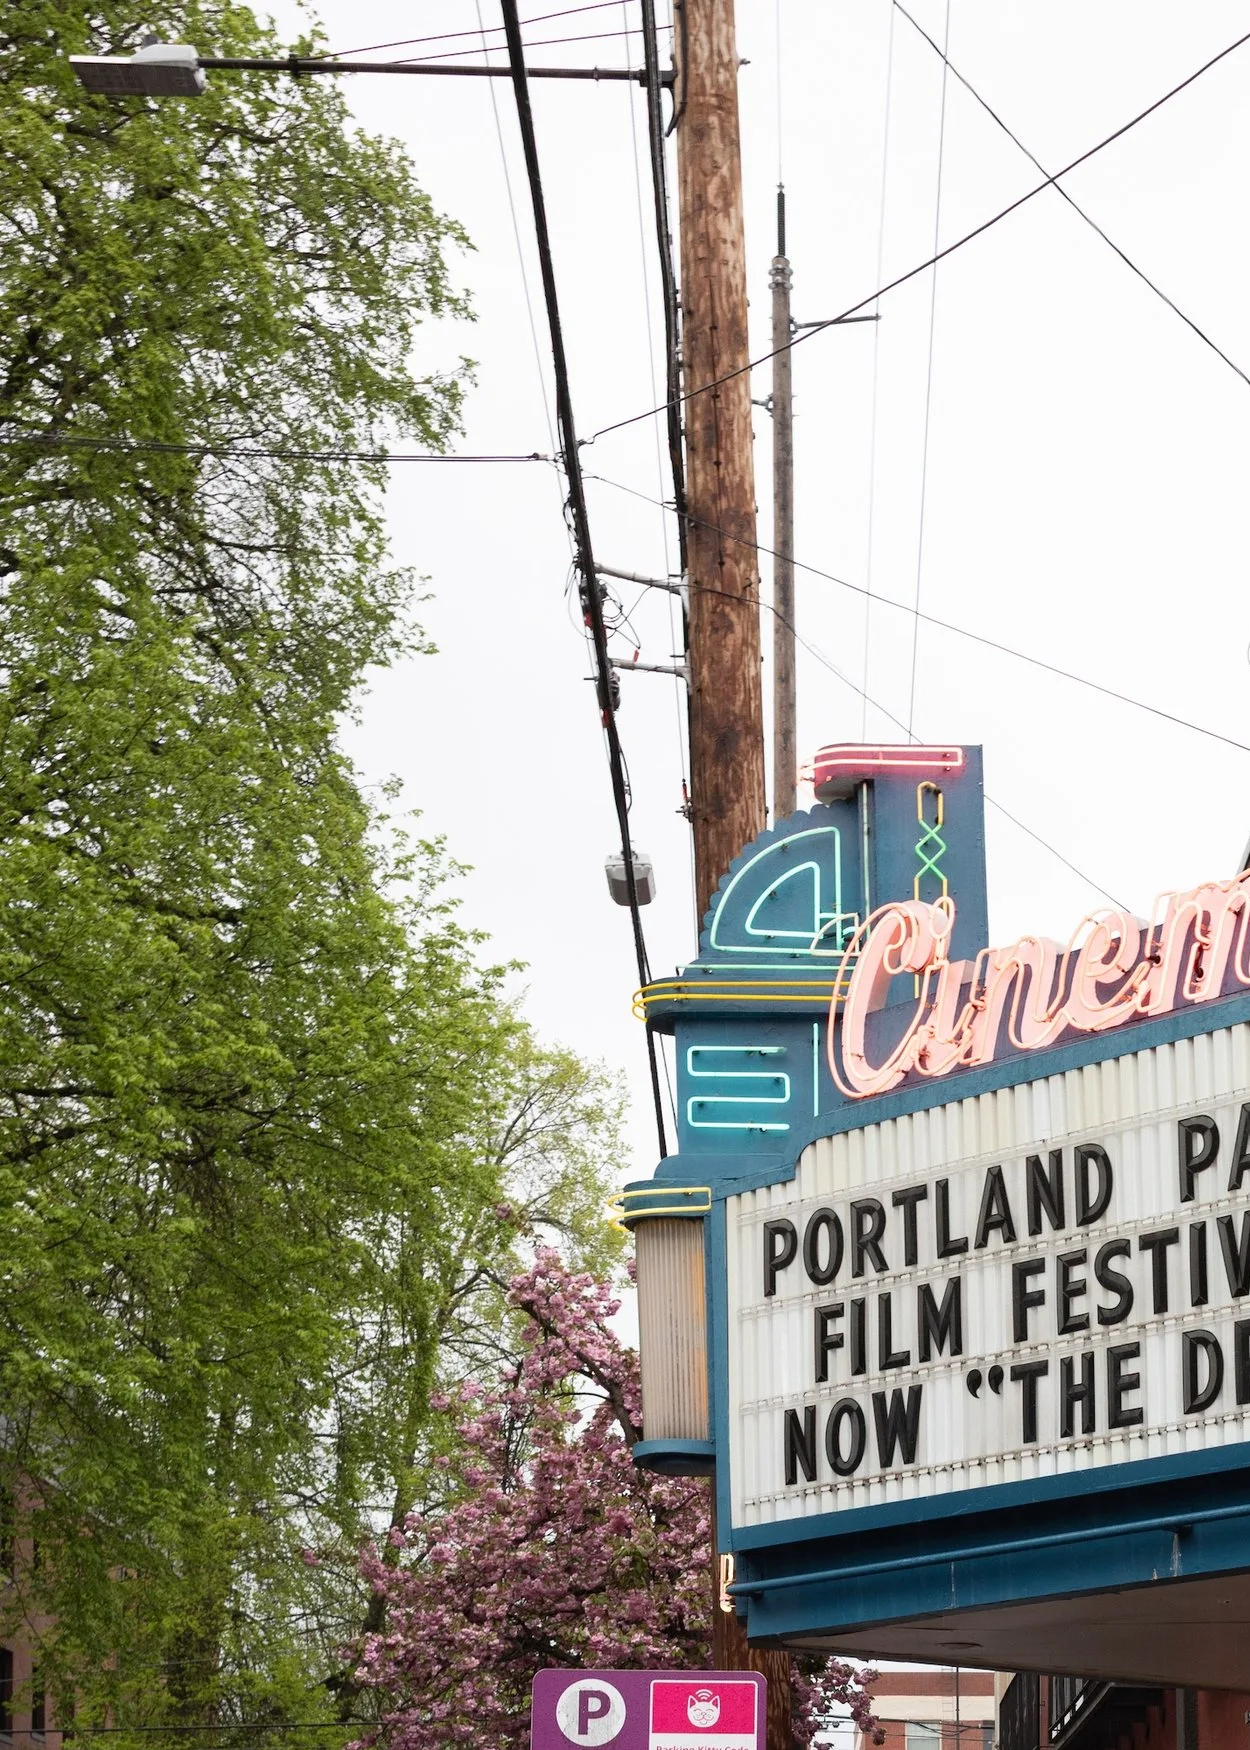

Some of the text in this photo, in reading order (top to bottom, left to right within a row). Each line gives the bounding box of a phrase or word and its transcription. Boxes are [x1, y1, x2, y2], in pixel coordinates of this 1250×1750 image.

[763, 1141, 1114, 1298] PORTLAND
[813, 1277, 963, 1384] FILM
[783, 1384, 924, 1485] NOW
[577, 1689, 611, 1736] P
